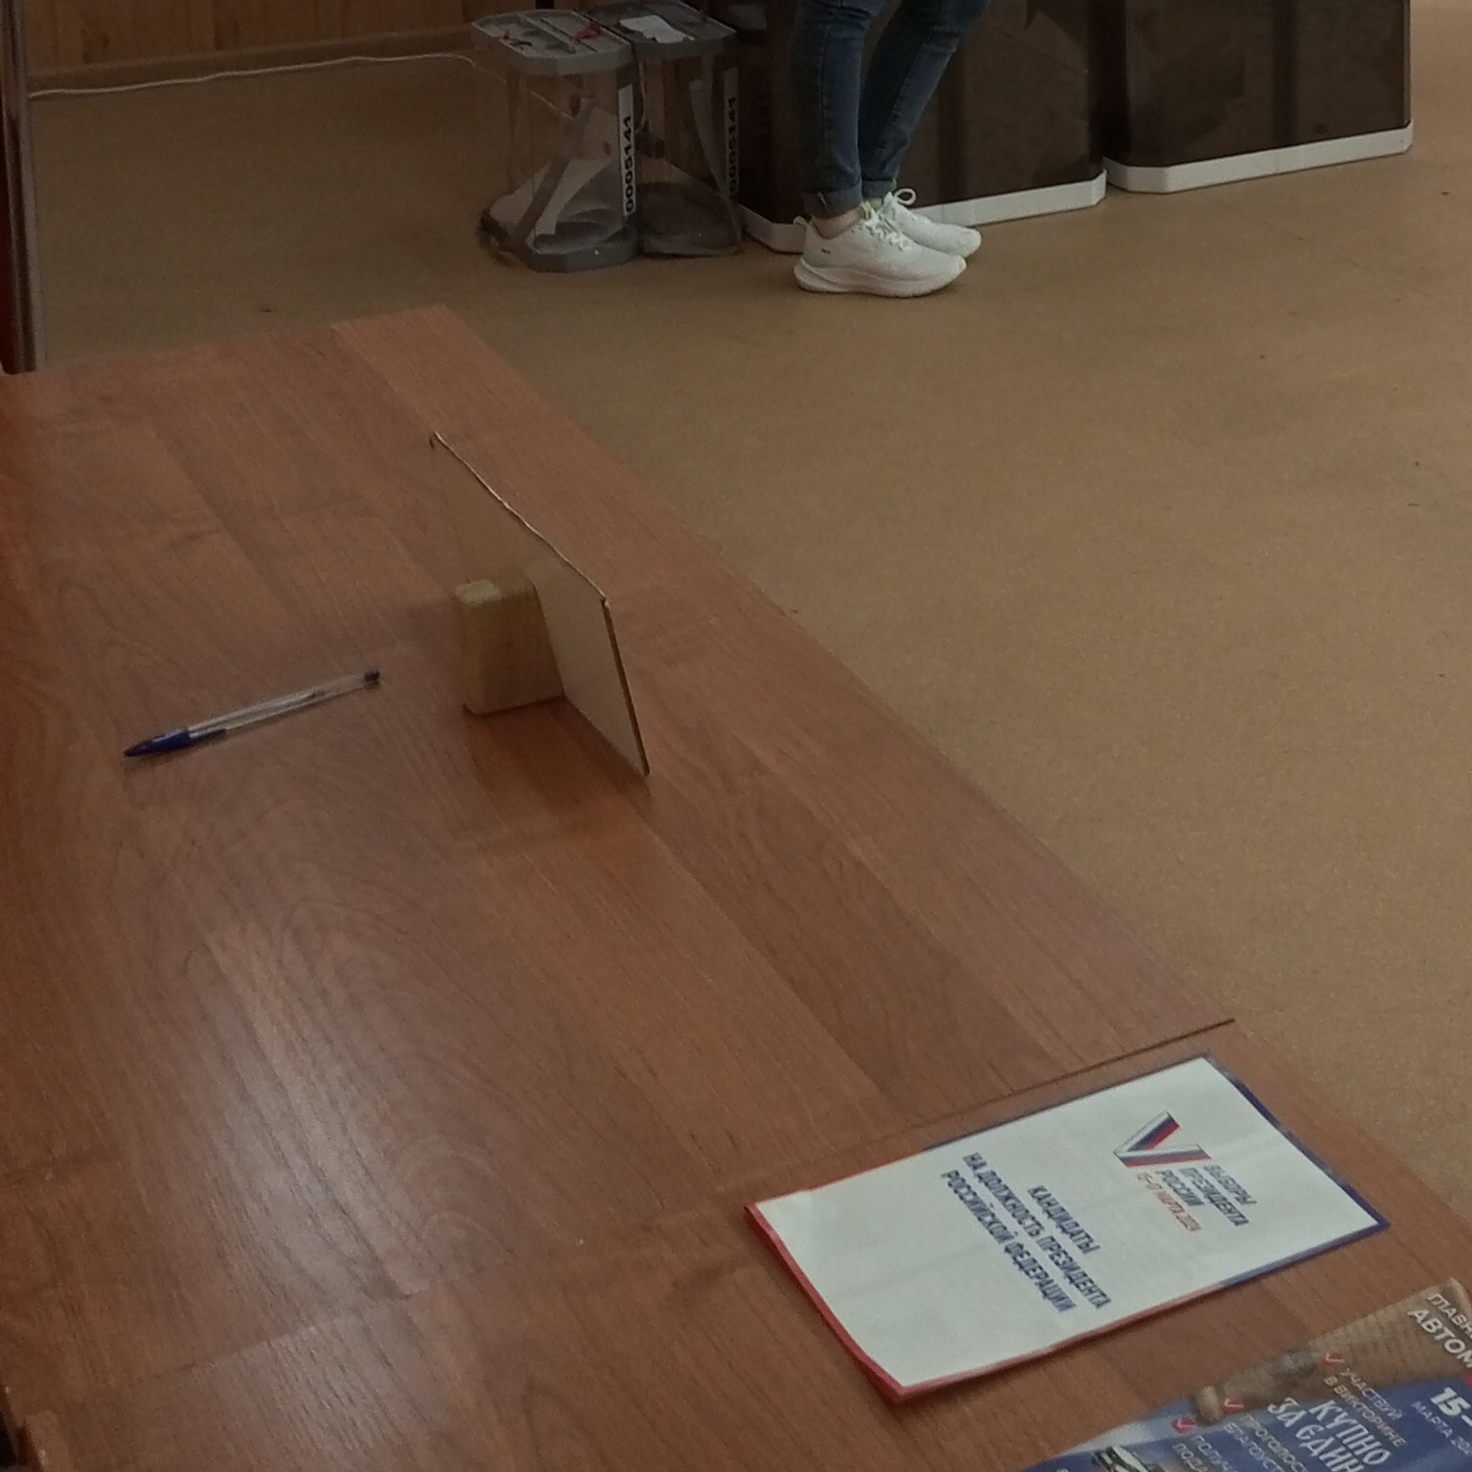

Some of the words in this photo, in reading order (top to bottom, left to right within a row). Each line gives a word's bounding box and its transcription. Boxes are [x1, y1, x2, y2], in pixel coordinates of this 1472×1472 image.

[623, 116, 634, 213] 0005141
[963, 1152, 988, 1173] НА
[974, 1169, 1046, 1238] ДОЛЖНОСТЬ
[1027, 1185, 1100, 1255] КАНДИДАТЫ
[940, 1169, 1019, 1246] РОССИЙСКОЙ
[1004, 1241, 1078, 1313] ФЕДЕРАЦИИ
[1036, 1235, 1112, 1310] ПРЕЗИДЕНТА
[1267, 1397, 1307, 1428] ЗА
[1324, 1376, 1338, 1386] В
[1333, 1384, 1407, 1448] ВИКТОРИНЕ
[1340, 1368, 1403, 1421] УЧАСТВУЙ
[1411, 1400, 1453, 1439] МАРТА
[1308, 1400, 1391, 1466] КУПНО
